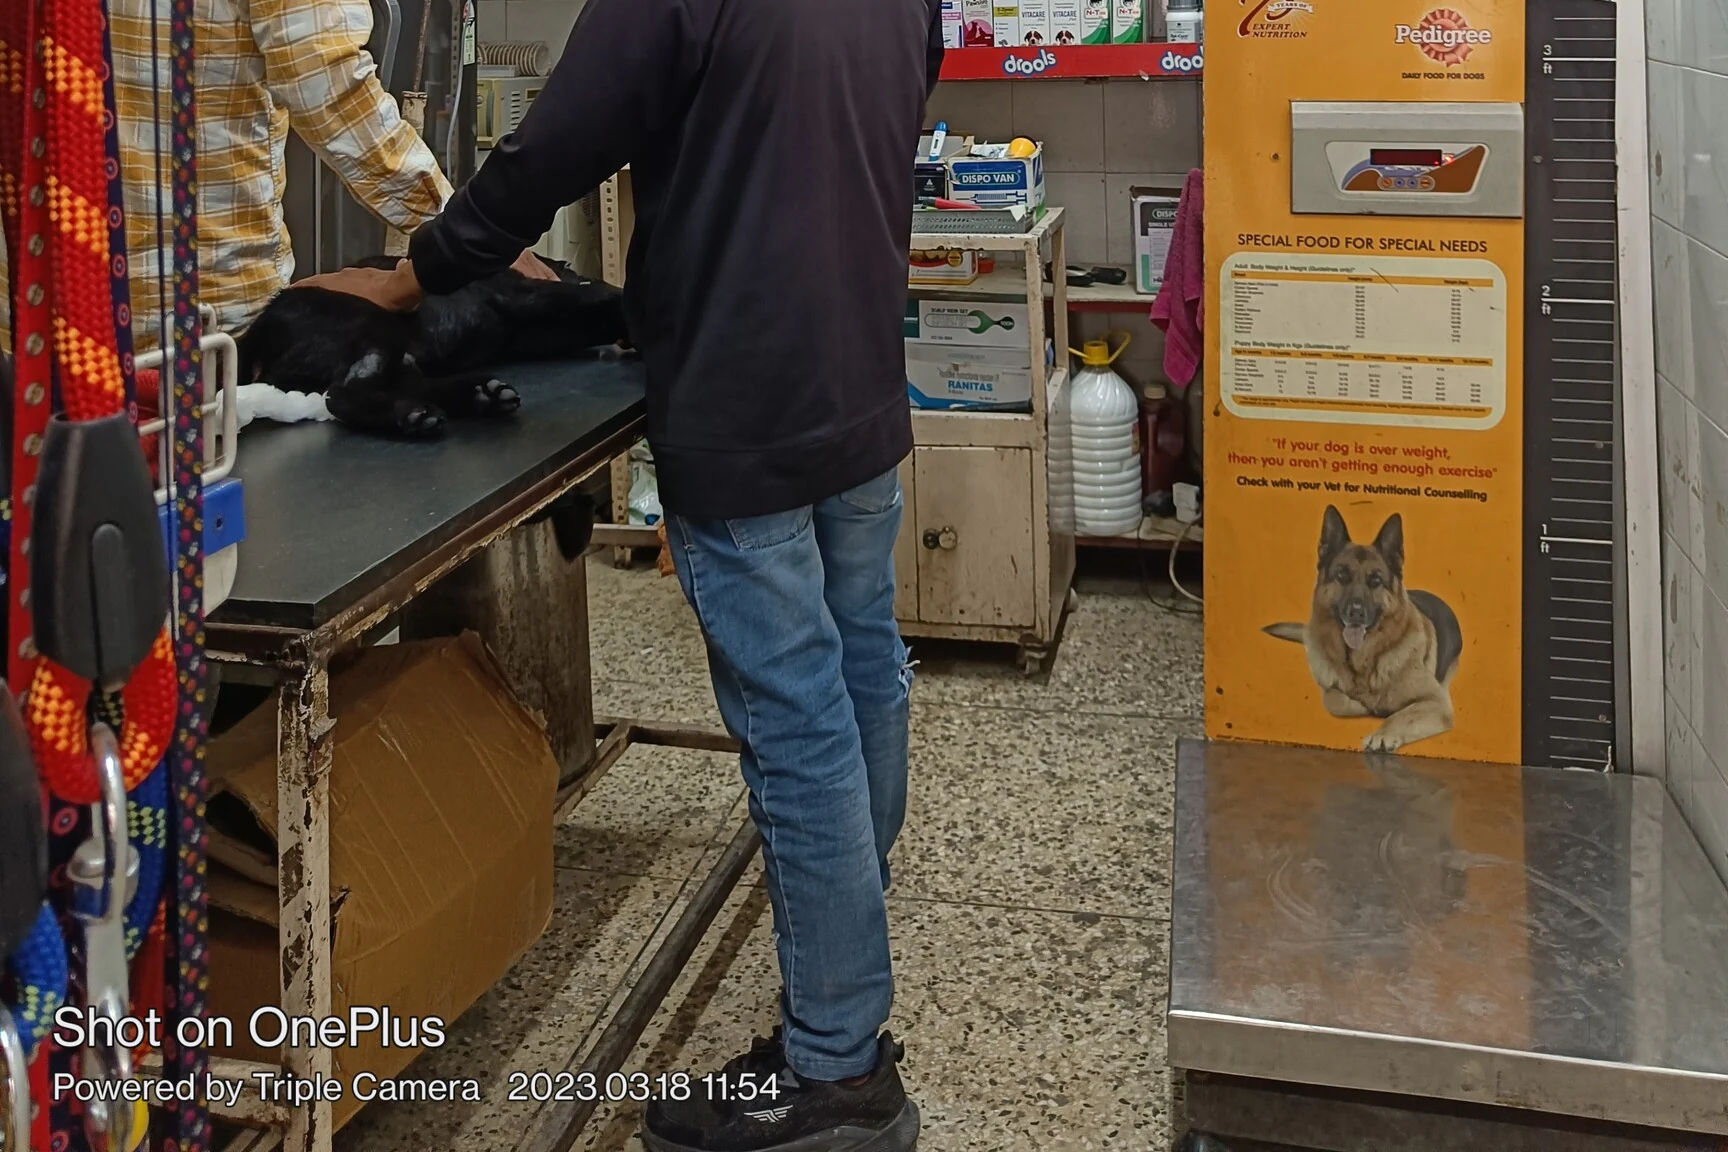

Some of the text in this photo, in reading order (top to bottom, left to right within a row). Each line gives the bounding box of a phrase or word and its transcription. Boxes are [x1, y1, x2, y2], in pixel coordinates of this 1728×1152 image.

[1022, 11, 1046, 19] VITACARE
[1052, 10, 1077, 18] VITACARE
[1252, 23, 1291, 31] EXPERT
[1252, 31, 1308, 39] NUTRITION
[1395, 24, 1492, 48] Pedigree
[1543, 44, 1553, 56] 3
[1004, 49, 1056, 75] drools
[962, 174, 1015, 183] DISPO VAN
[1237, 233, 1488, 253] SPECIAL FOOD FOR SPECIAL NEEDS
[1541, 285, 1551, 297] 2
[947, 380, 994, 392] RANITAS
[1272, 438, 1451, 460] "If your dog is over weight,
[1227, 451, 1498, 479] then you aren't getting enough exercise"
[1236, 475, 1488, 503] Check with your Vet for Nutritional Counselling
[1541, 523, 1548, 535] 1
